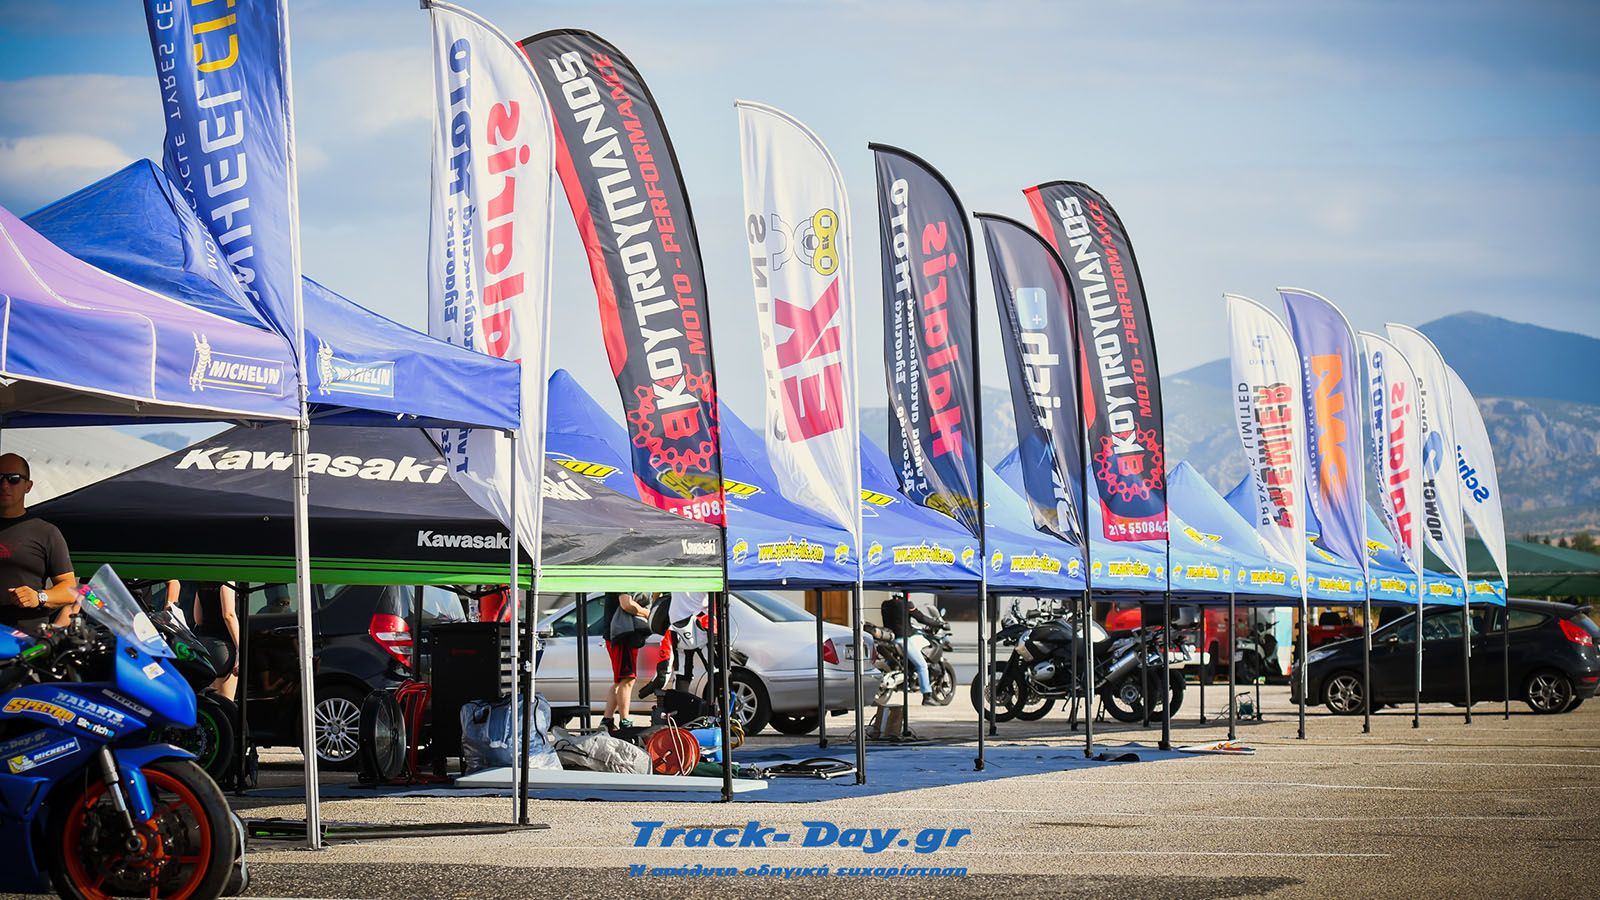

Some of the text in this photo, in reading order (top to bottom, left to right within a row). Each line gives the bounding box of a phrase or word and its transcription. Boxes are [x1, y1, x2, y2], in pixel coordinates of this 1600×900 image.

[591, 52, 682, 253] PERFORMANCE
[1086, 199, 1140, 343] PERFORMANCE
[672, 273, 706, 356] MOTO
[209, 360, 280, 385] MICHELIN
[335, 366, 391, 386] MICHELIN
[1131, 359, 1153, 418] MOTO
[174, 446, 448, 484] Kawasaki
[33, 741, 76, 761] MICHELIN
